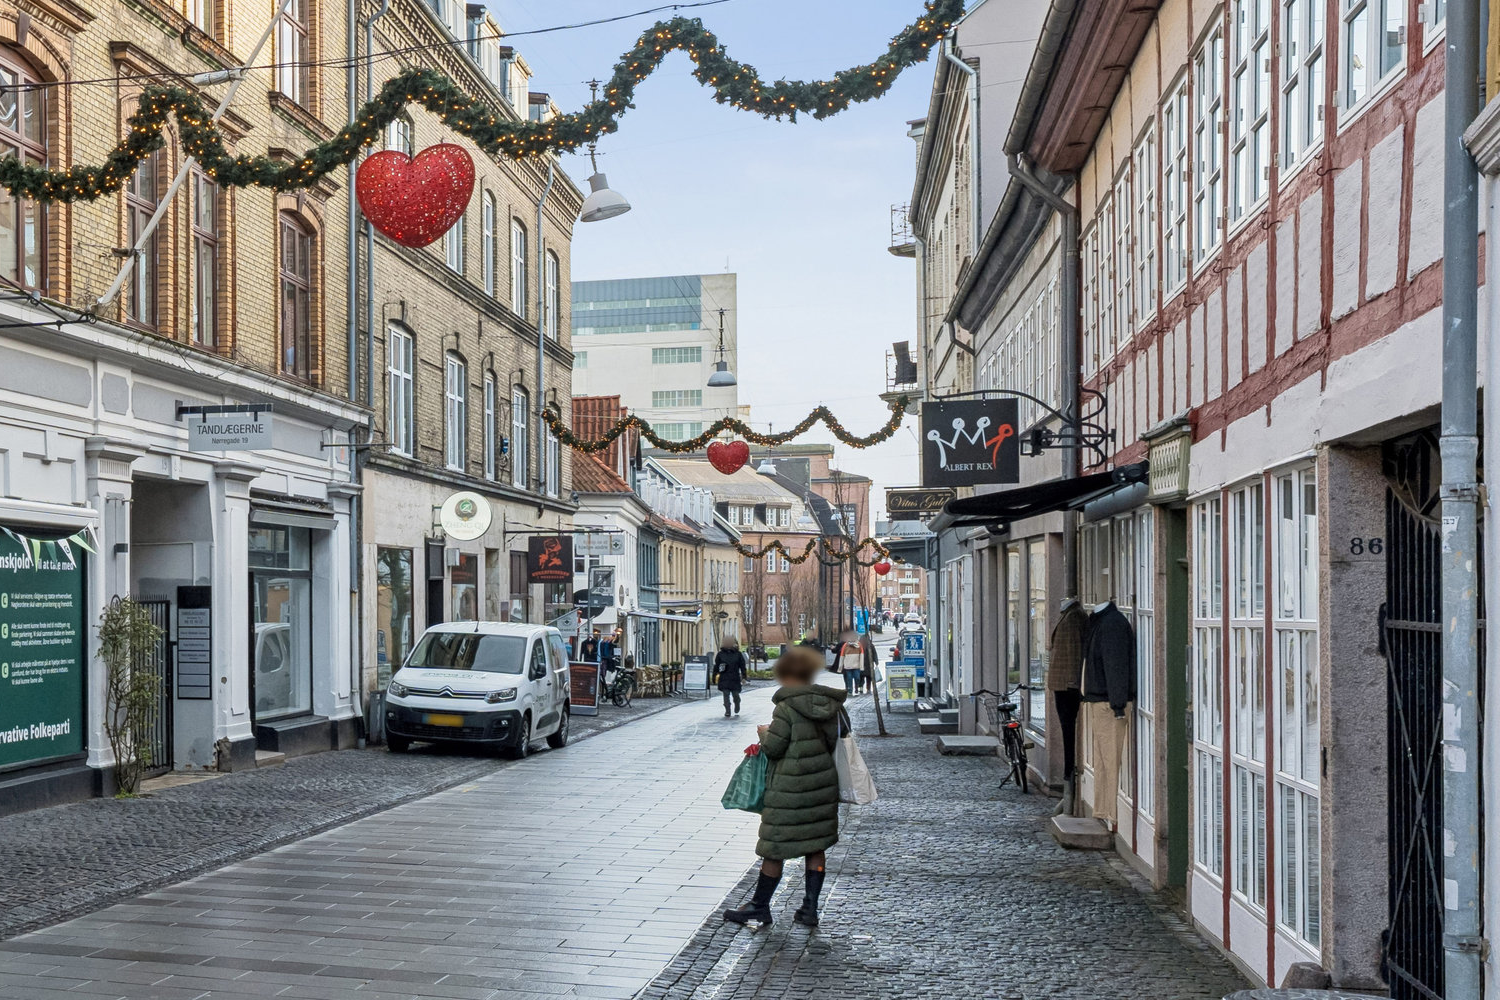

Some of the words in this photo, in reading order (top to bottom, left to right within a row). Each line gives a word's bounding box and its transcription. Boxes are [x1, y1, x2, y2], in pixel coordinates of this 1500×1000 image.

[197, 424, 264, 435] TANDLÆGERNE
[944, 463, 974, 471] ALBERT
[890, 495, 917, 507] Vitus
[1350, 538, 1383, 555] 86
[43, 560, 49, 570] at
[30, 718, 70, 740] Folkeparti
